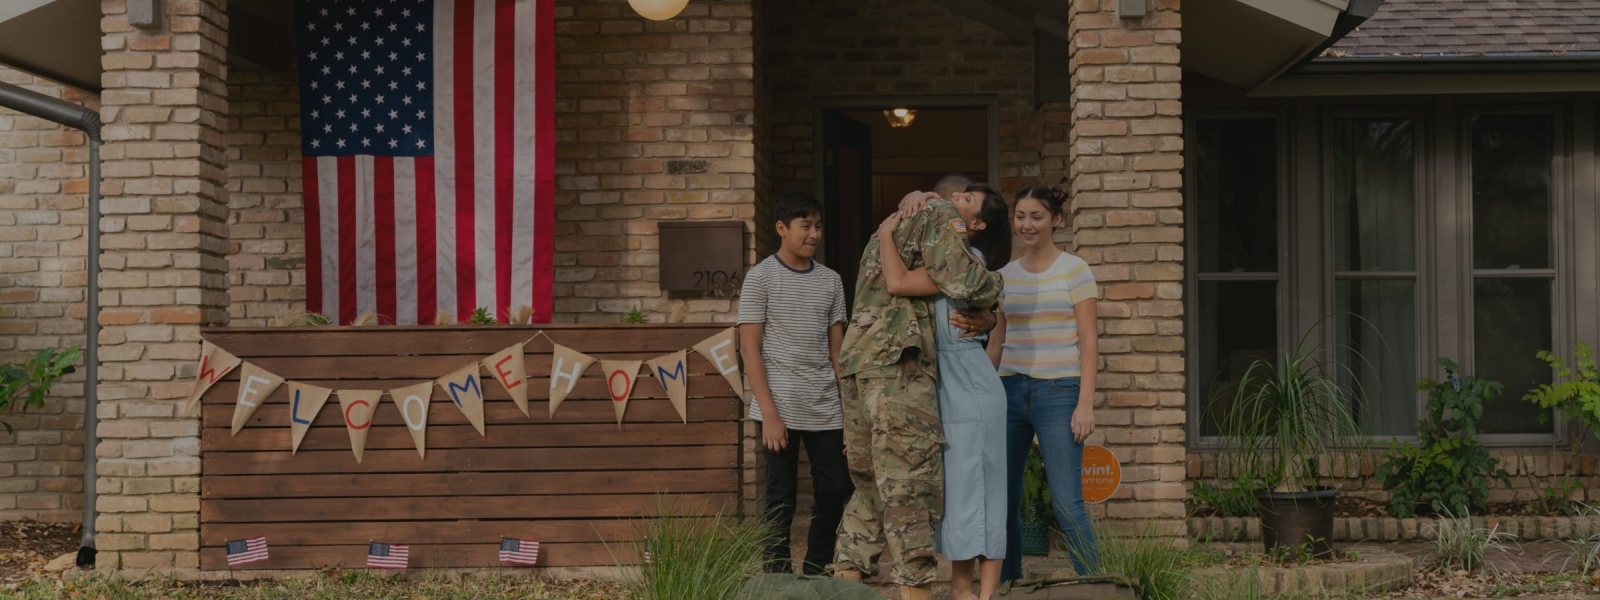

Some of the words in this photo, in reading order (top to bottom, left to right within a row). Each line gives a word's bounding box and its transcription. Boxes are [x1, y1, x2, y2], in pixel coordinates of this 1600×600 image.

[693, 270, 741, 288] 2106
[199, 354, 521, 431] WELCOME
[551, 338, 739, 401] HOME
[1082, 463, 1114, 475] vint.
